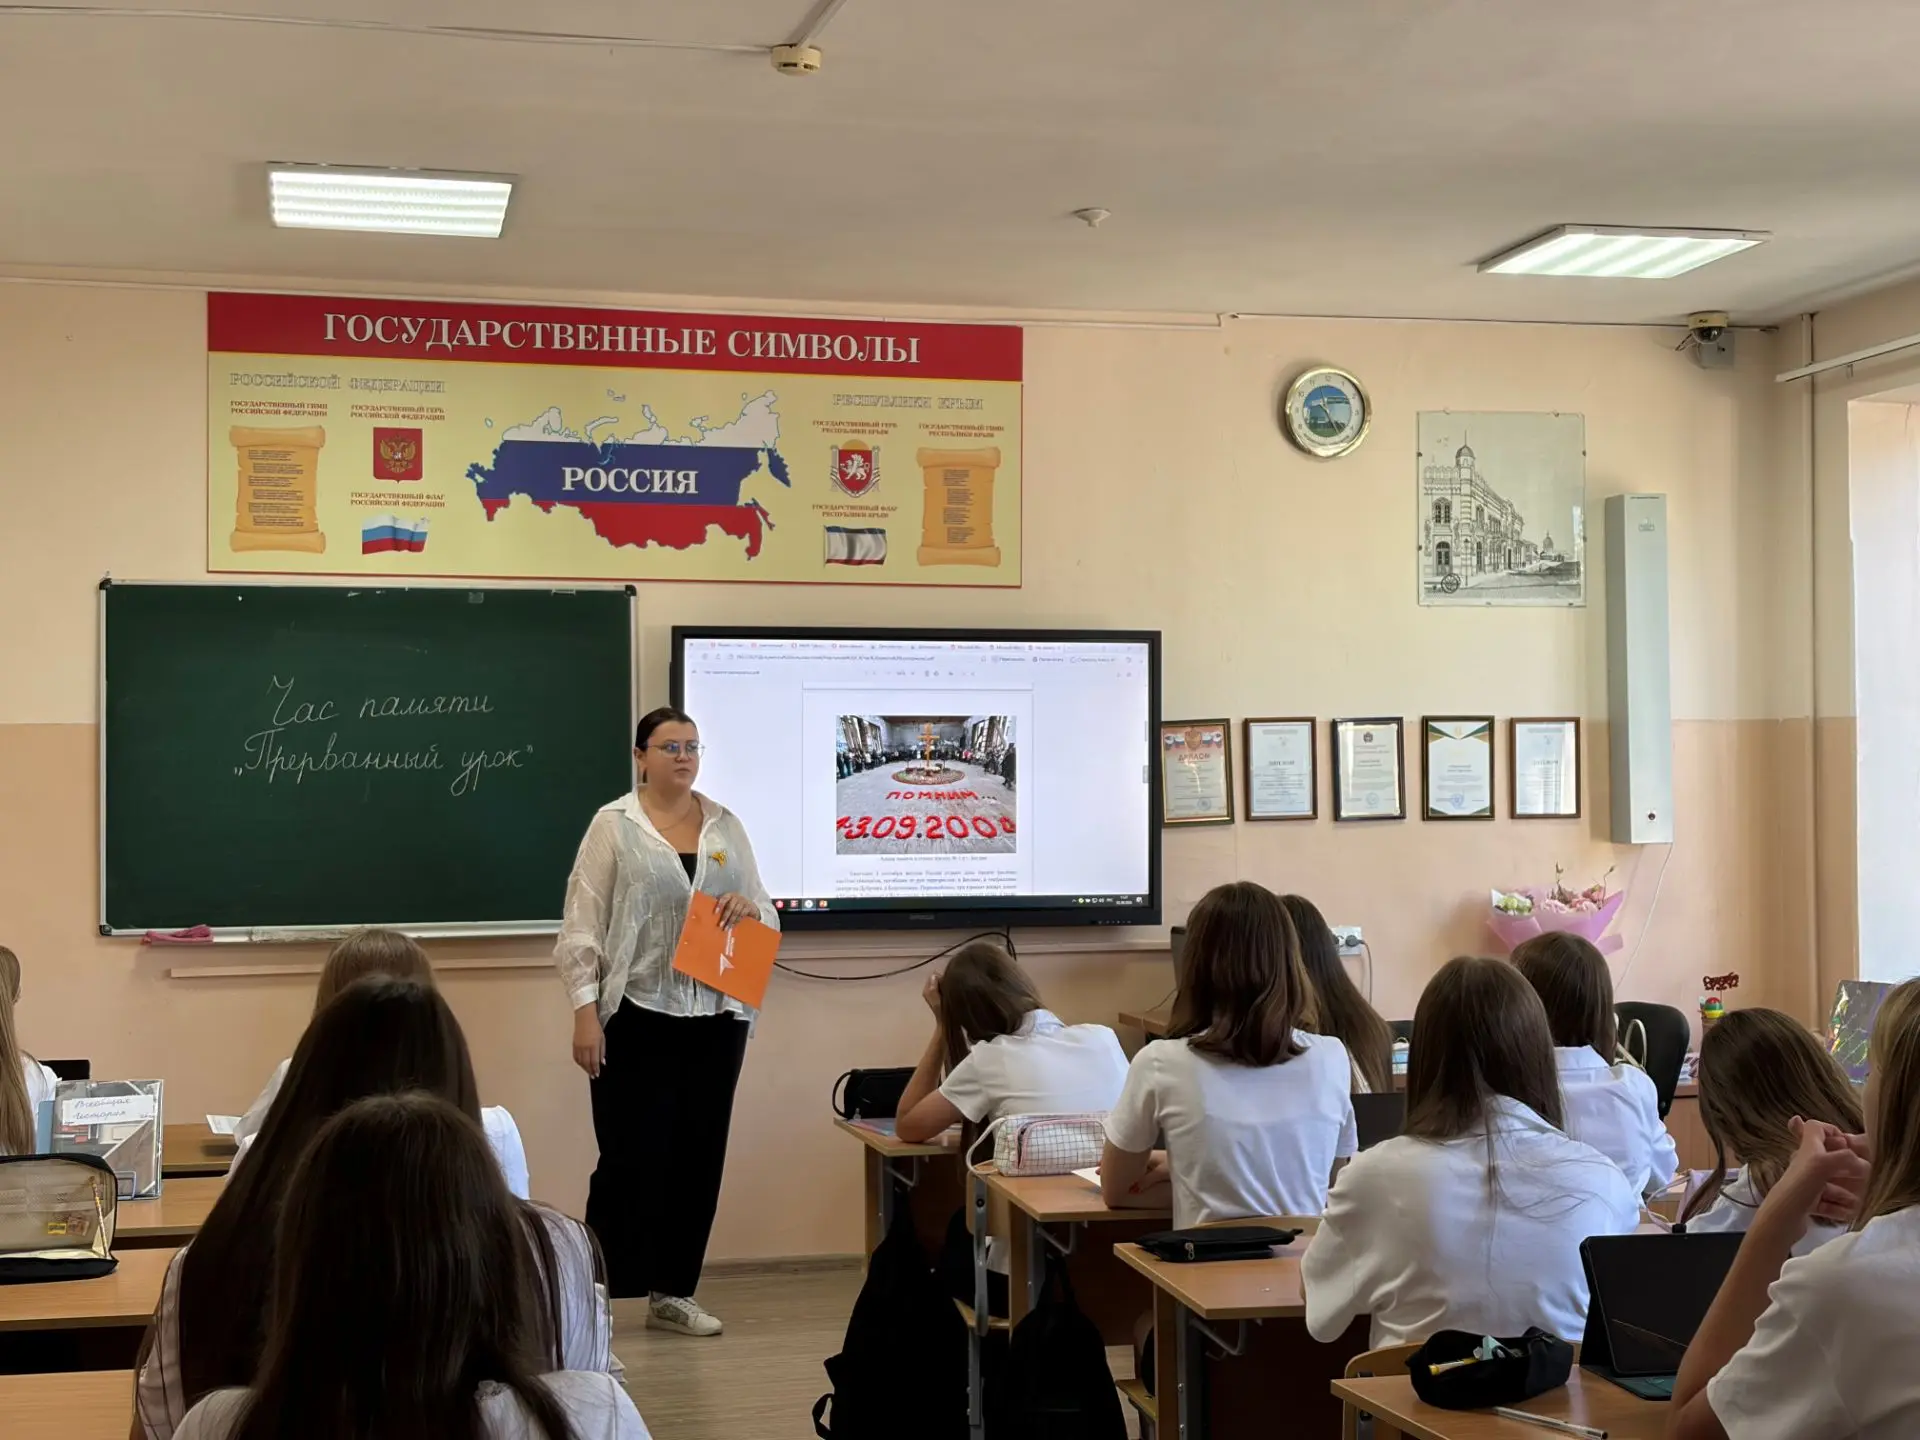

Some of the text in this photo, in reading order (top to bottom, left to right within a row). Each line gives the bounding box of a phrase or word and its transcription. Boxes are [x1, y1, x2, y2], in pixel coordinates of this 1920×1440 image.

[324, 313, 920, 364] ГОСУДАРСТВЕННЫЕ СИМВОЛЫ
[230, 372, 446, 394] РОССИЙСКОЙ ФЕДЕРАЦИИ
[832, 393, 932, 409] РЕСПУБЛИКИ
[562, 467, 698, 495] РОССИЯ
[266, 674, 495, 726] Час памяти
